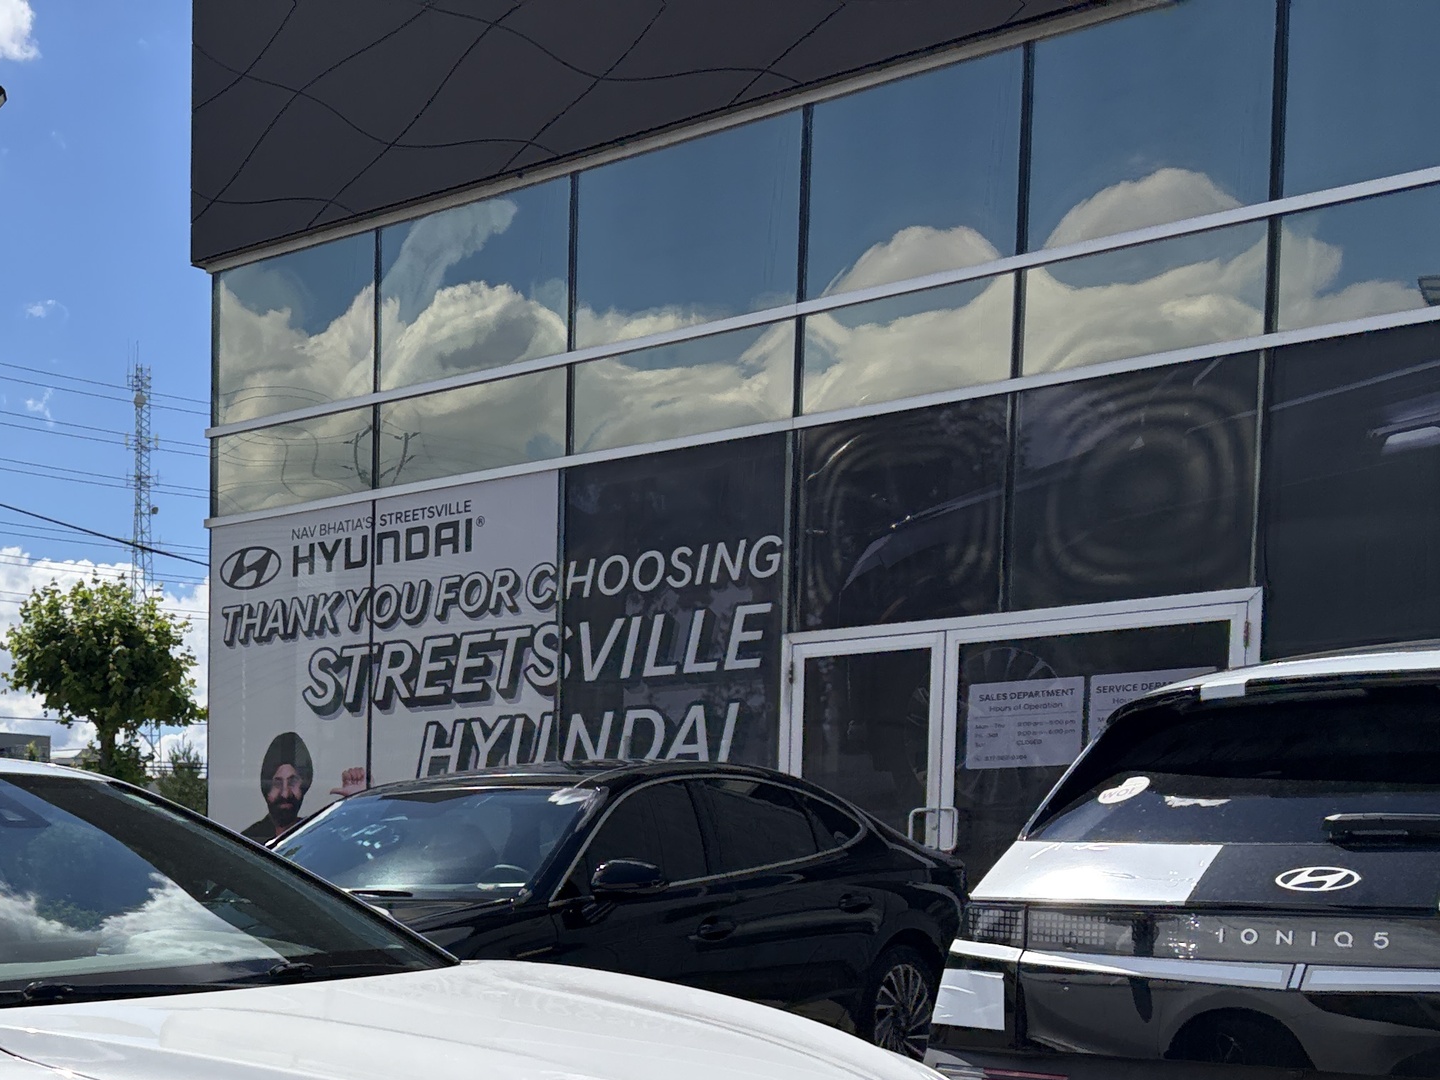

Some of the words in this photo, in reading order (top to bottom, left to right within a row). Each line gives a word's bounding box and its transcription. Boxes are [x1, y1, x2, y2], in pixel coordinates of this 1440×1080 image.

[291, 525, 318, 541] NAV
[319, 516, 375, 537] BHATIA'S
[379, 500, 472, 527] STREETSVILLE
[222, 590, 344, 648] THANK
[345, 579, 433, 632] YOU
[436, 568, 520, 622] FOR
[526, 534, 783, 611] CHOOSING
[302, 602, 773, 718] STREETSVILLE
[978, 692, 1008, 702] SALES
[1009, 688, 1076, 700] DEPARTMENT
[1096, 683, 1139, 694] SERVICE
[989, 704, 1012, 713] Hours
[1013, 703, 1021, 711] of
[1023, 702, 1063, 712] Operation
[417, 701, 742, 779] HYUNDAI
[1218, 928, 1354, 948] IONIQ
[1373, 931, 1389, 949] 5
